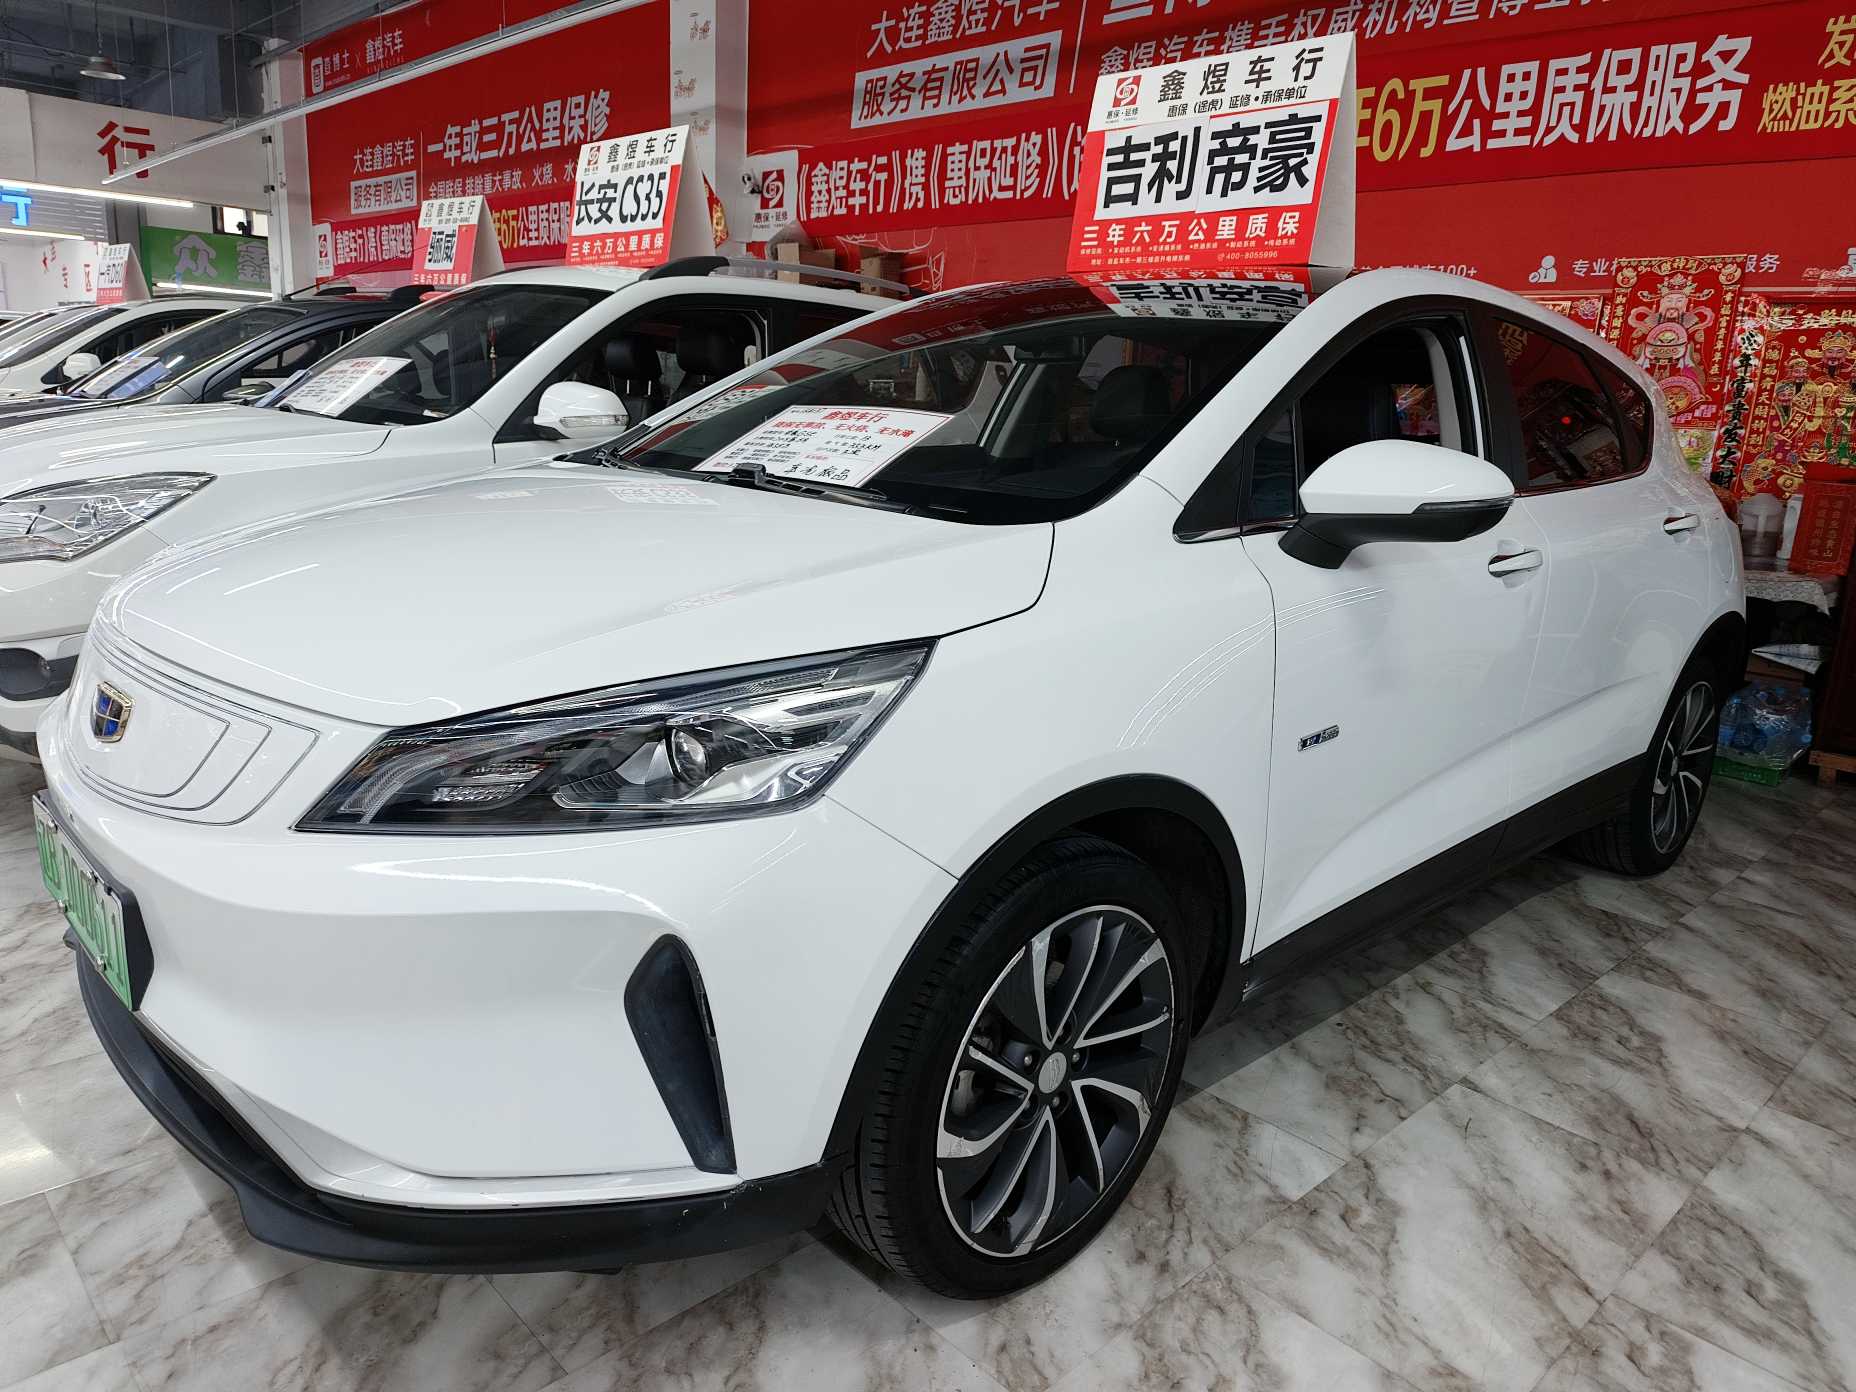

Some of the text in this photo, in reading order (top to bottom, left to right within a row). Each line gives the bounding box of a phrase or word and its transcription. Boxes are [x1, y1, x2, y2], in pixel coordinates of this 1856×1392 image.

[859, 42, 1052, 121] 服务有限公司
[1157, 47, 1325, 103] 鑫煜车行
[428, 89, 611, 167] 一年或三万公里保修
[98, 120, 155, 178] 行
[353, 137, 415, 175] 大连鑫煜汽车
[607, 133, 677, 164] 鑫煜车行
[354, 176, 414, 209] 服务有限公司
[570, 233, 664, 257] 三年六万公里质保
[1081, 212, 1300, 246] 三年六万公里质保
